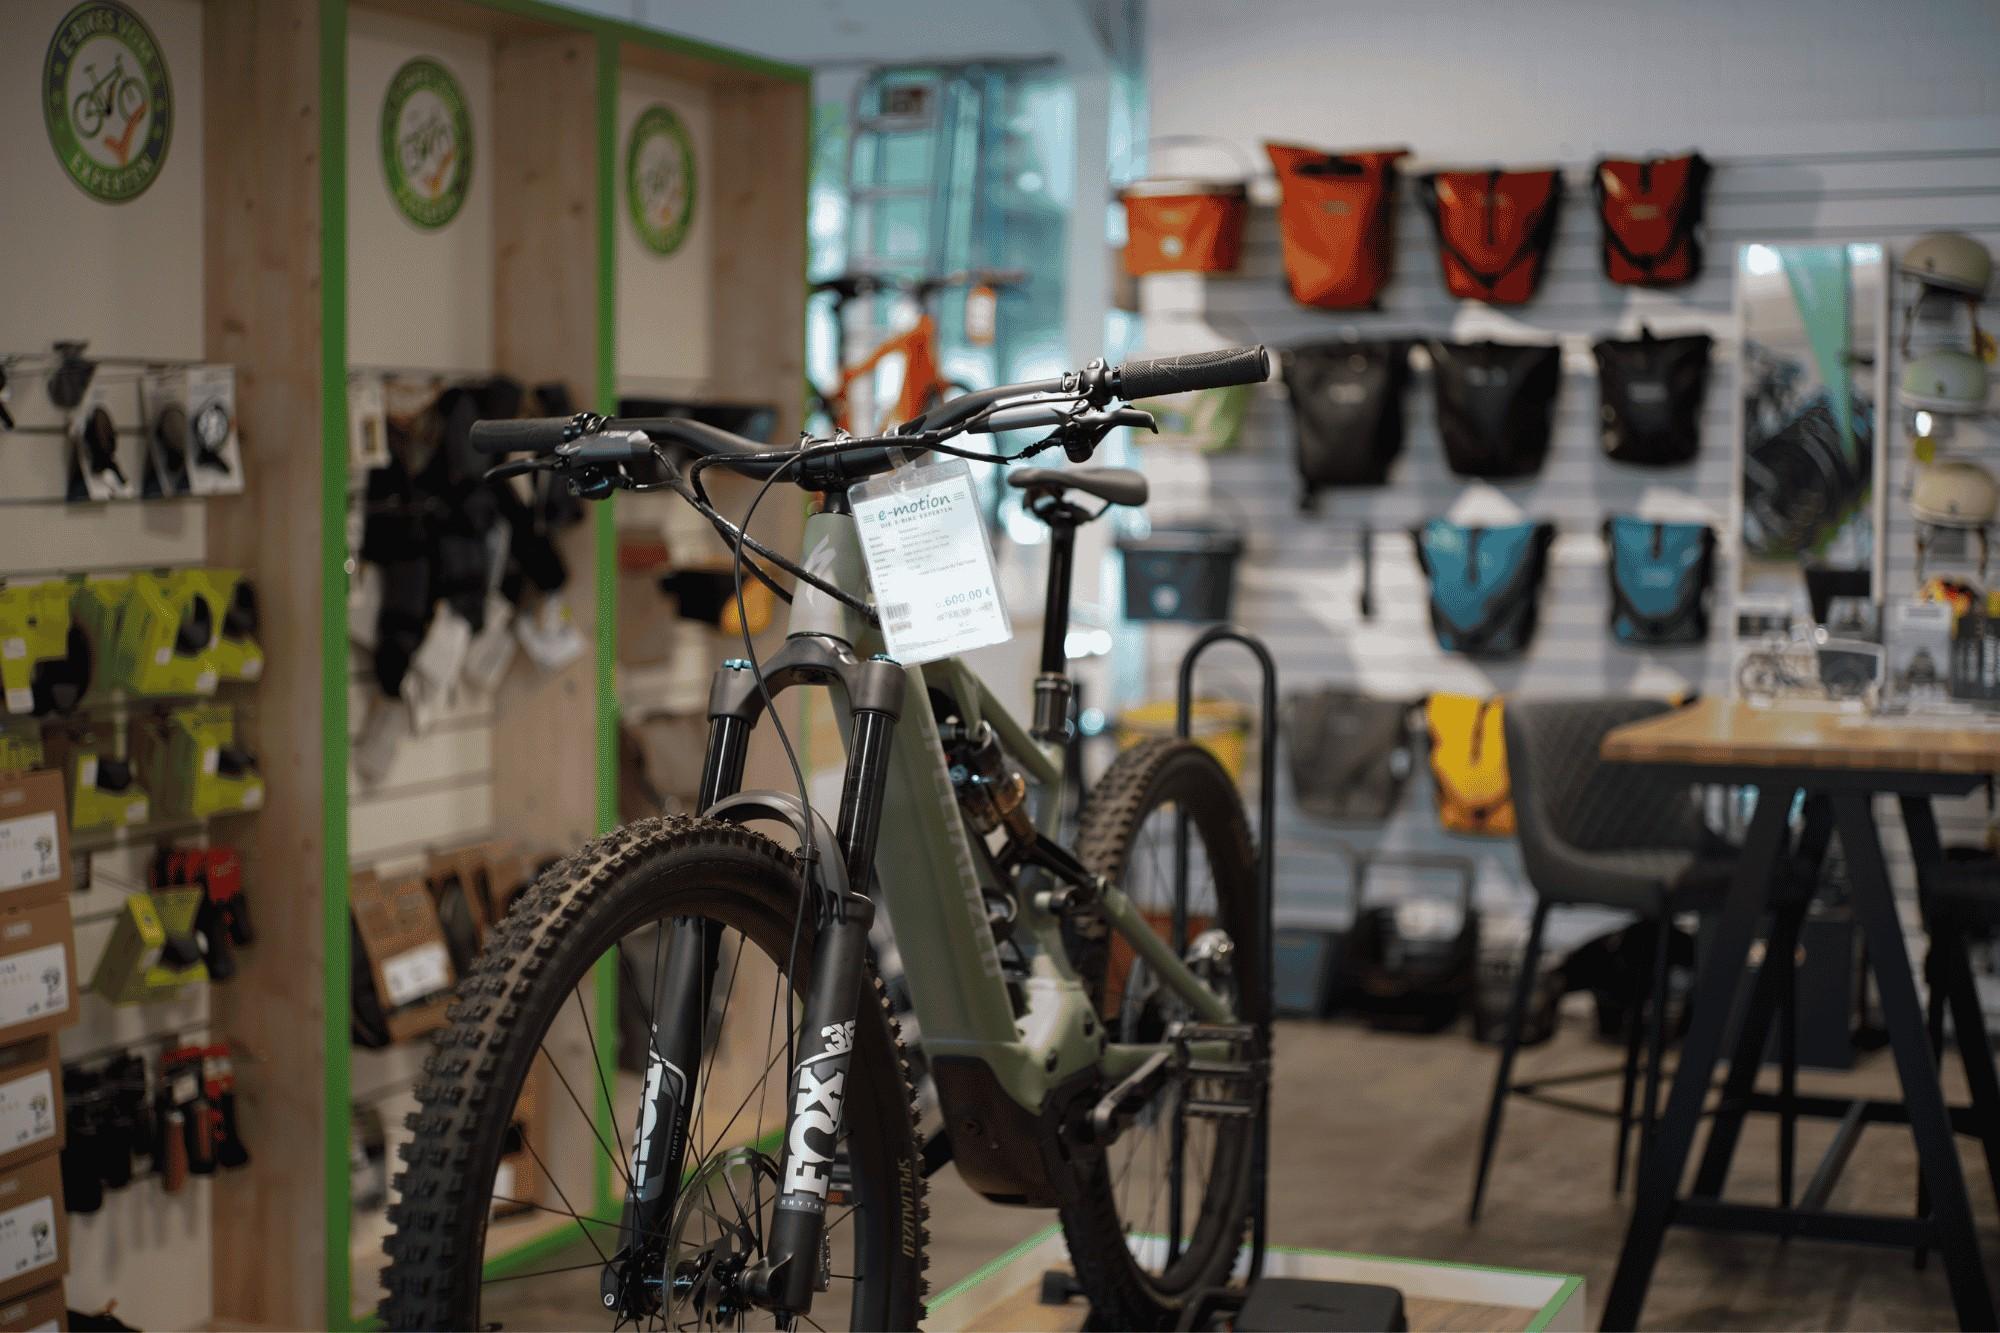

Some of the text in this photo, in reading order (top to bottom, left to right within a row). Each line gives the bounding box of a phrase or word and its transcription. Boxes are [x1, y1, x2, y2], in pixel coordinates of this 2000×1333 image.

[878, 493, 951, 521] e-motion
[782, 1066, 846, 1200] FOX
[897, 1157, 917, 1259] SPECIALIZED
